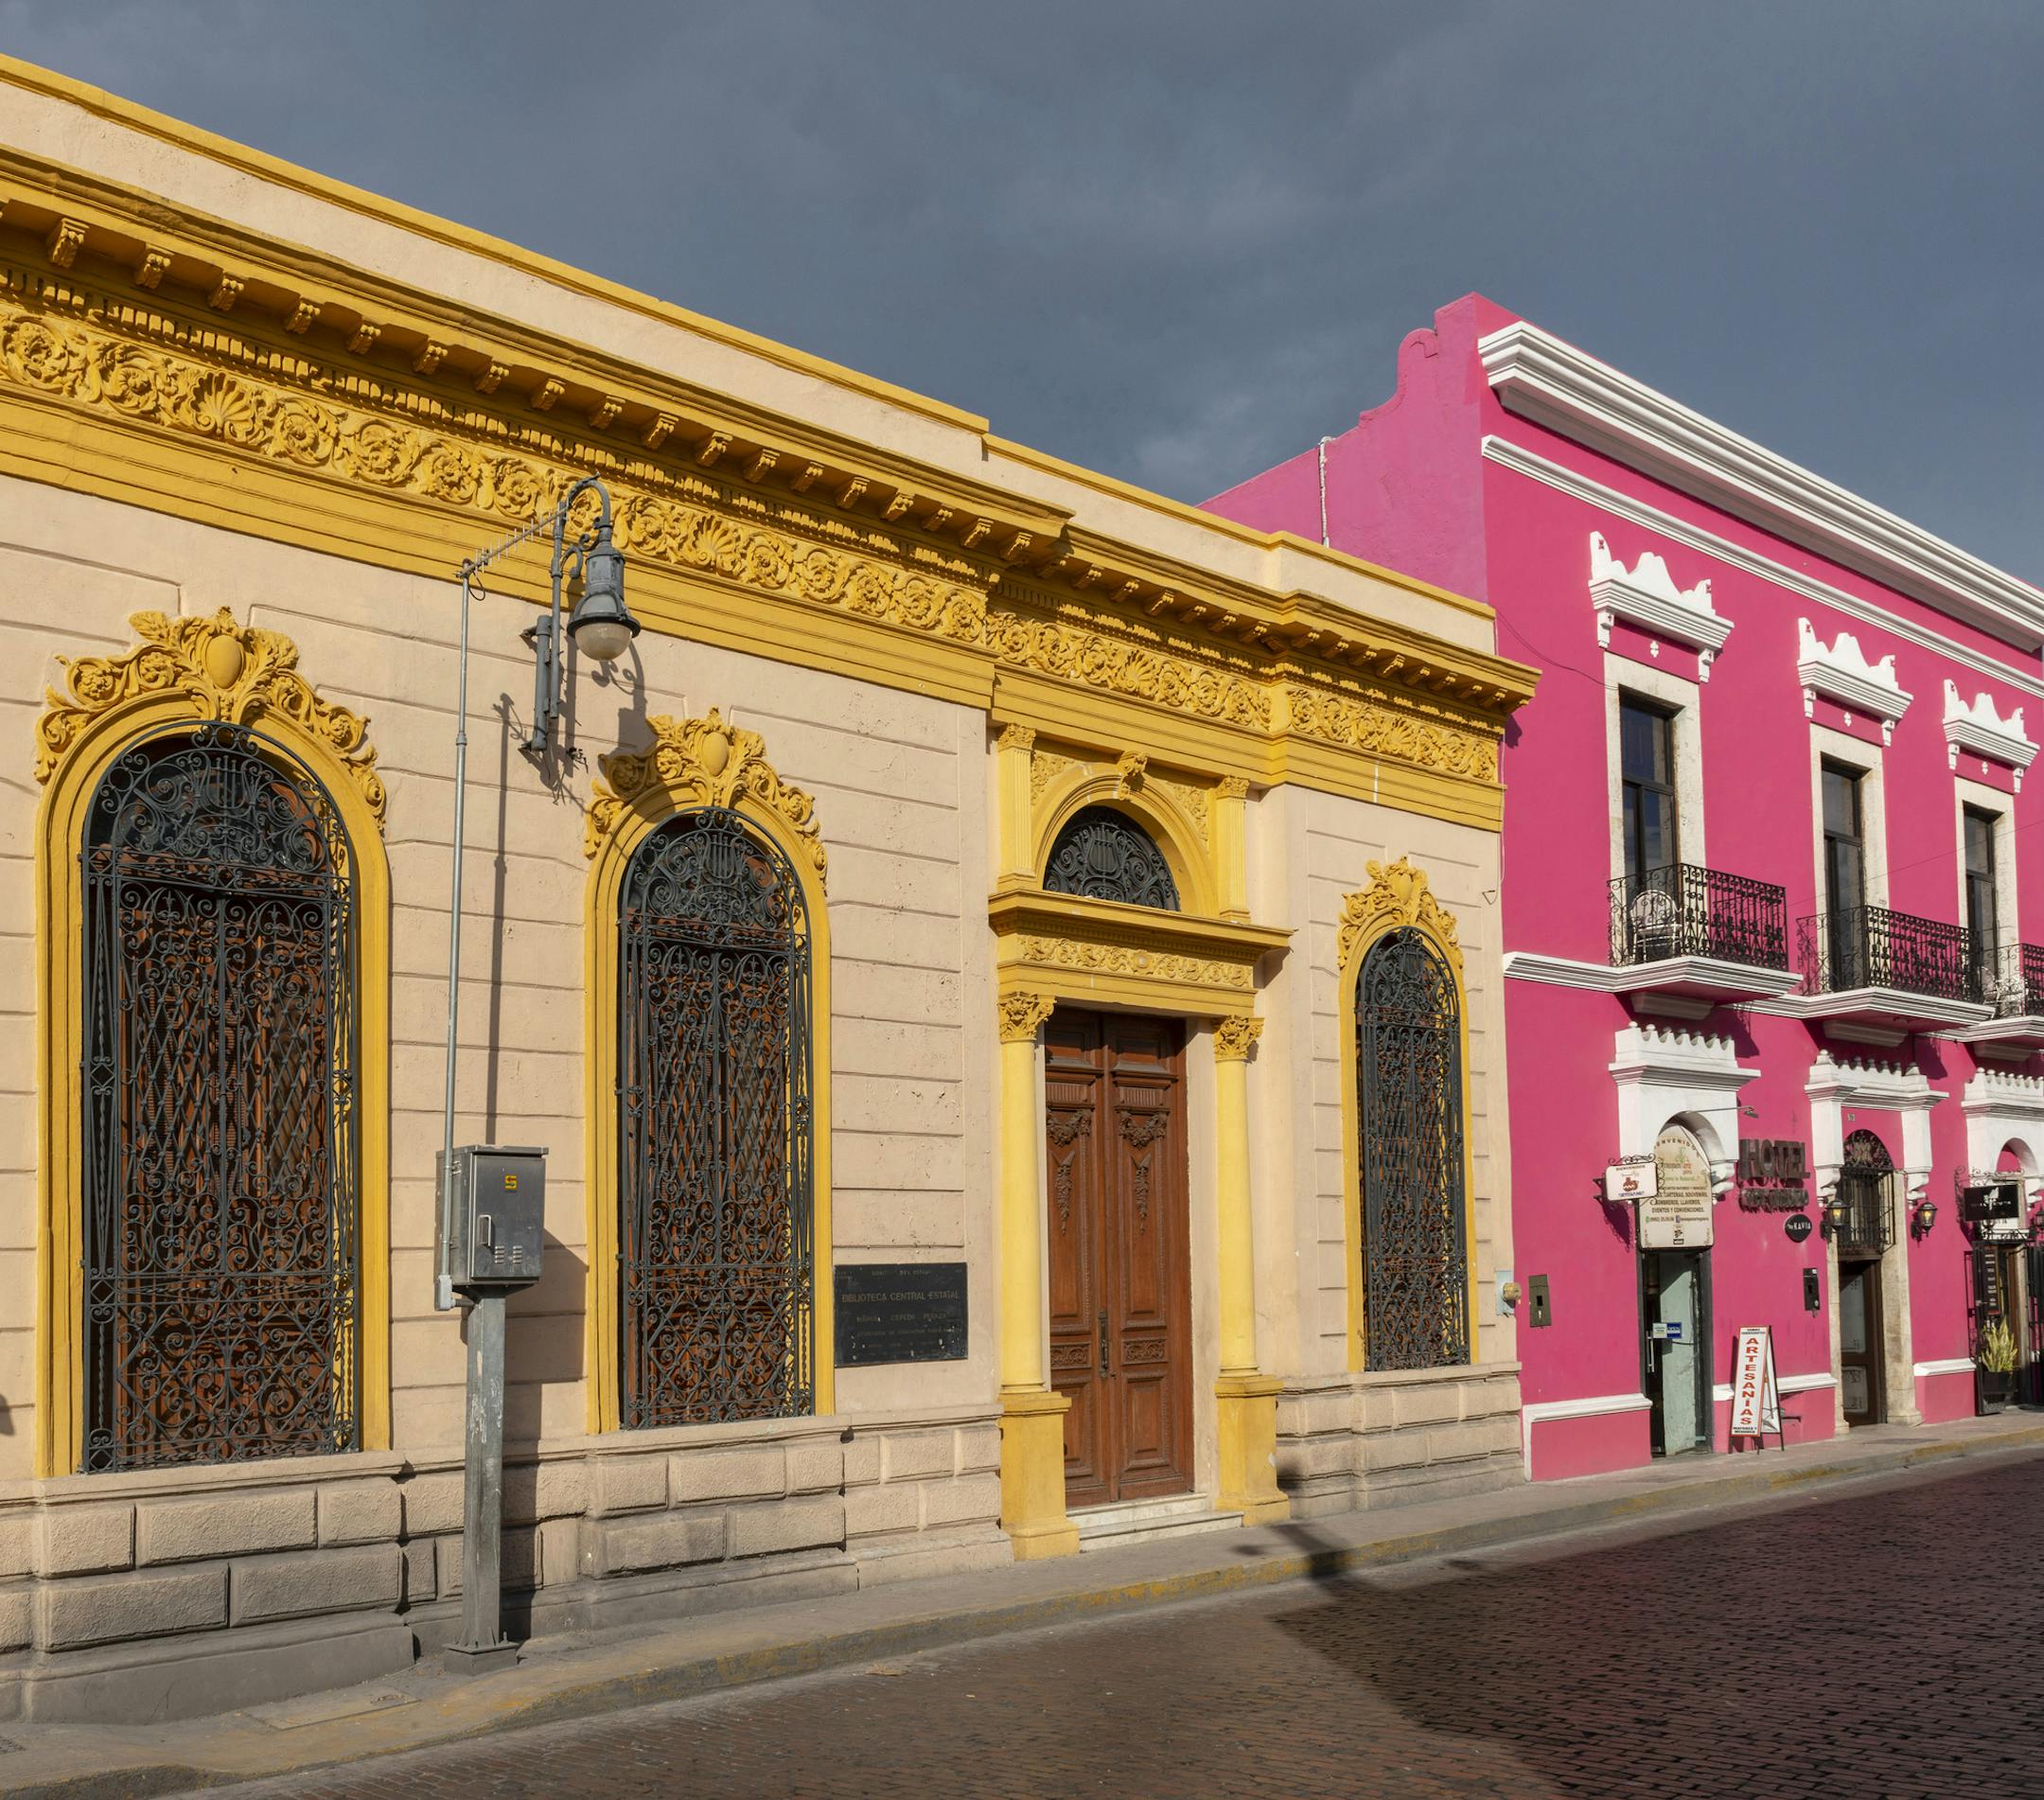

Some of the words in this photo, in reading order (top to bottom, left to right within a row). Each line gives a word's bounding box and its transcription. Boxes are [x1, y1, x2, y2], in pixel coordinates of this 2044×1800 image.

[1739, 1138, 1810, 1179] HOTEL
[841, 1292, 888, 1303] BIBLIOTECA
[890, 1291, 926, 1301] CENTRAL
[927, 1289, 960, 1300] ESTATAL
[1740, 1337, 1759, 1425] ARTESANÍAS
